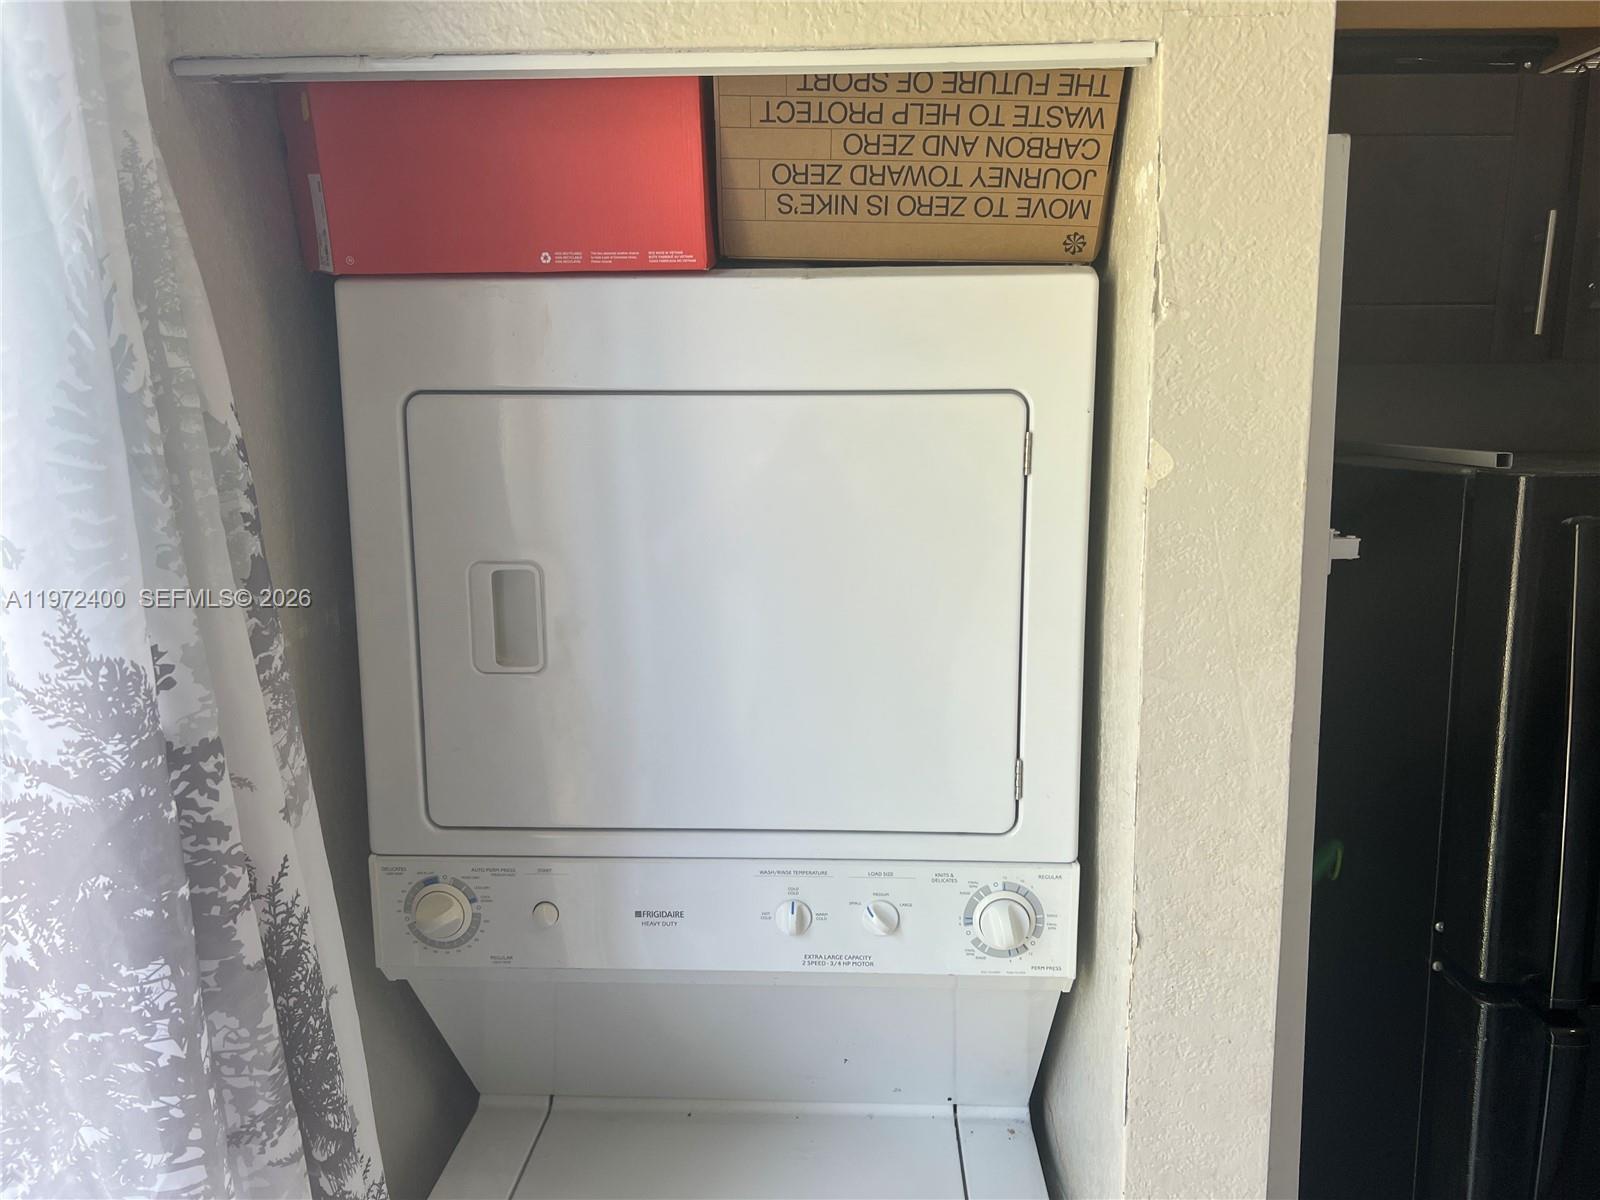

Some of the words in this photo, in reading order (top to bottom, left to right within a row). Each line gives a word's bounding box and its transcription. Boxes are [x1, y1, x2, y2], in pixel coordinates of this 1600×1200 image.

[796, 72, 888, 92] SPORT
[897, 71, 934, 93] OF
[942, 71, 1050, 95] FUTURE
[1057, 73, 1111, 97] THE
[760, 101, 884, 124] PROTECT
[892, 103, 960, 125] HELP
[969, 104, 1005, 127] TO
[1013, 105, 1105, 129] WASTE
[843, 134, 915, 156] ZERO
[922, 135, 978, 157] AND
[985, 136, 1101, 160] CARBON
[771, 163, 843, 185] ZERO
[850, 165, 963, 187] TOWARD
[971, 167, 1097, 190] JOURNEY
[866, 194, 889, 216] IS
[897, 195, 967, 217] ZERO
[974, 197, 1008, 218] TO
[1016, 198, 1092, 219] MOVE
[642, 910, 685, 918] FRIGIDAIRE
